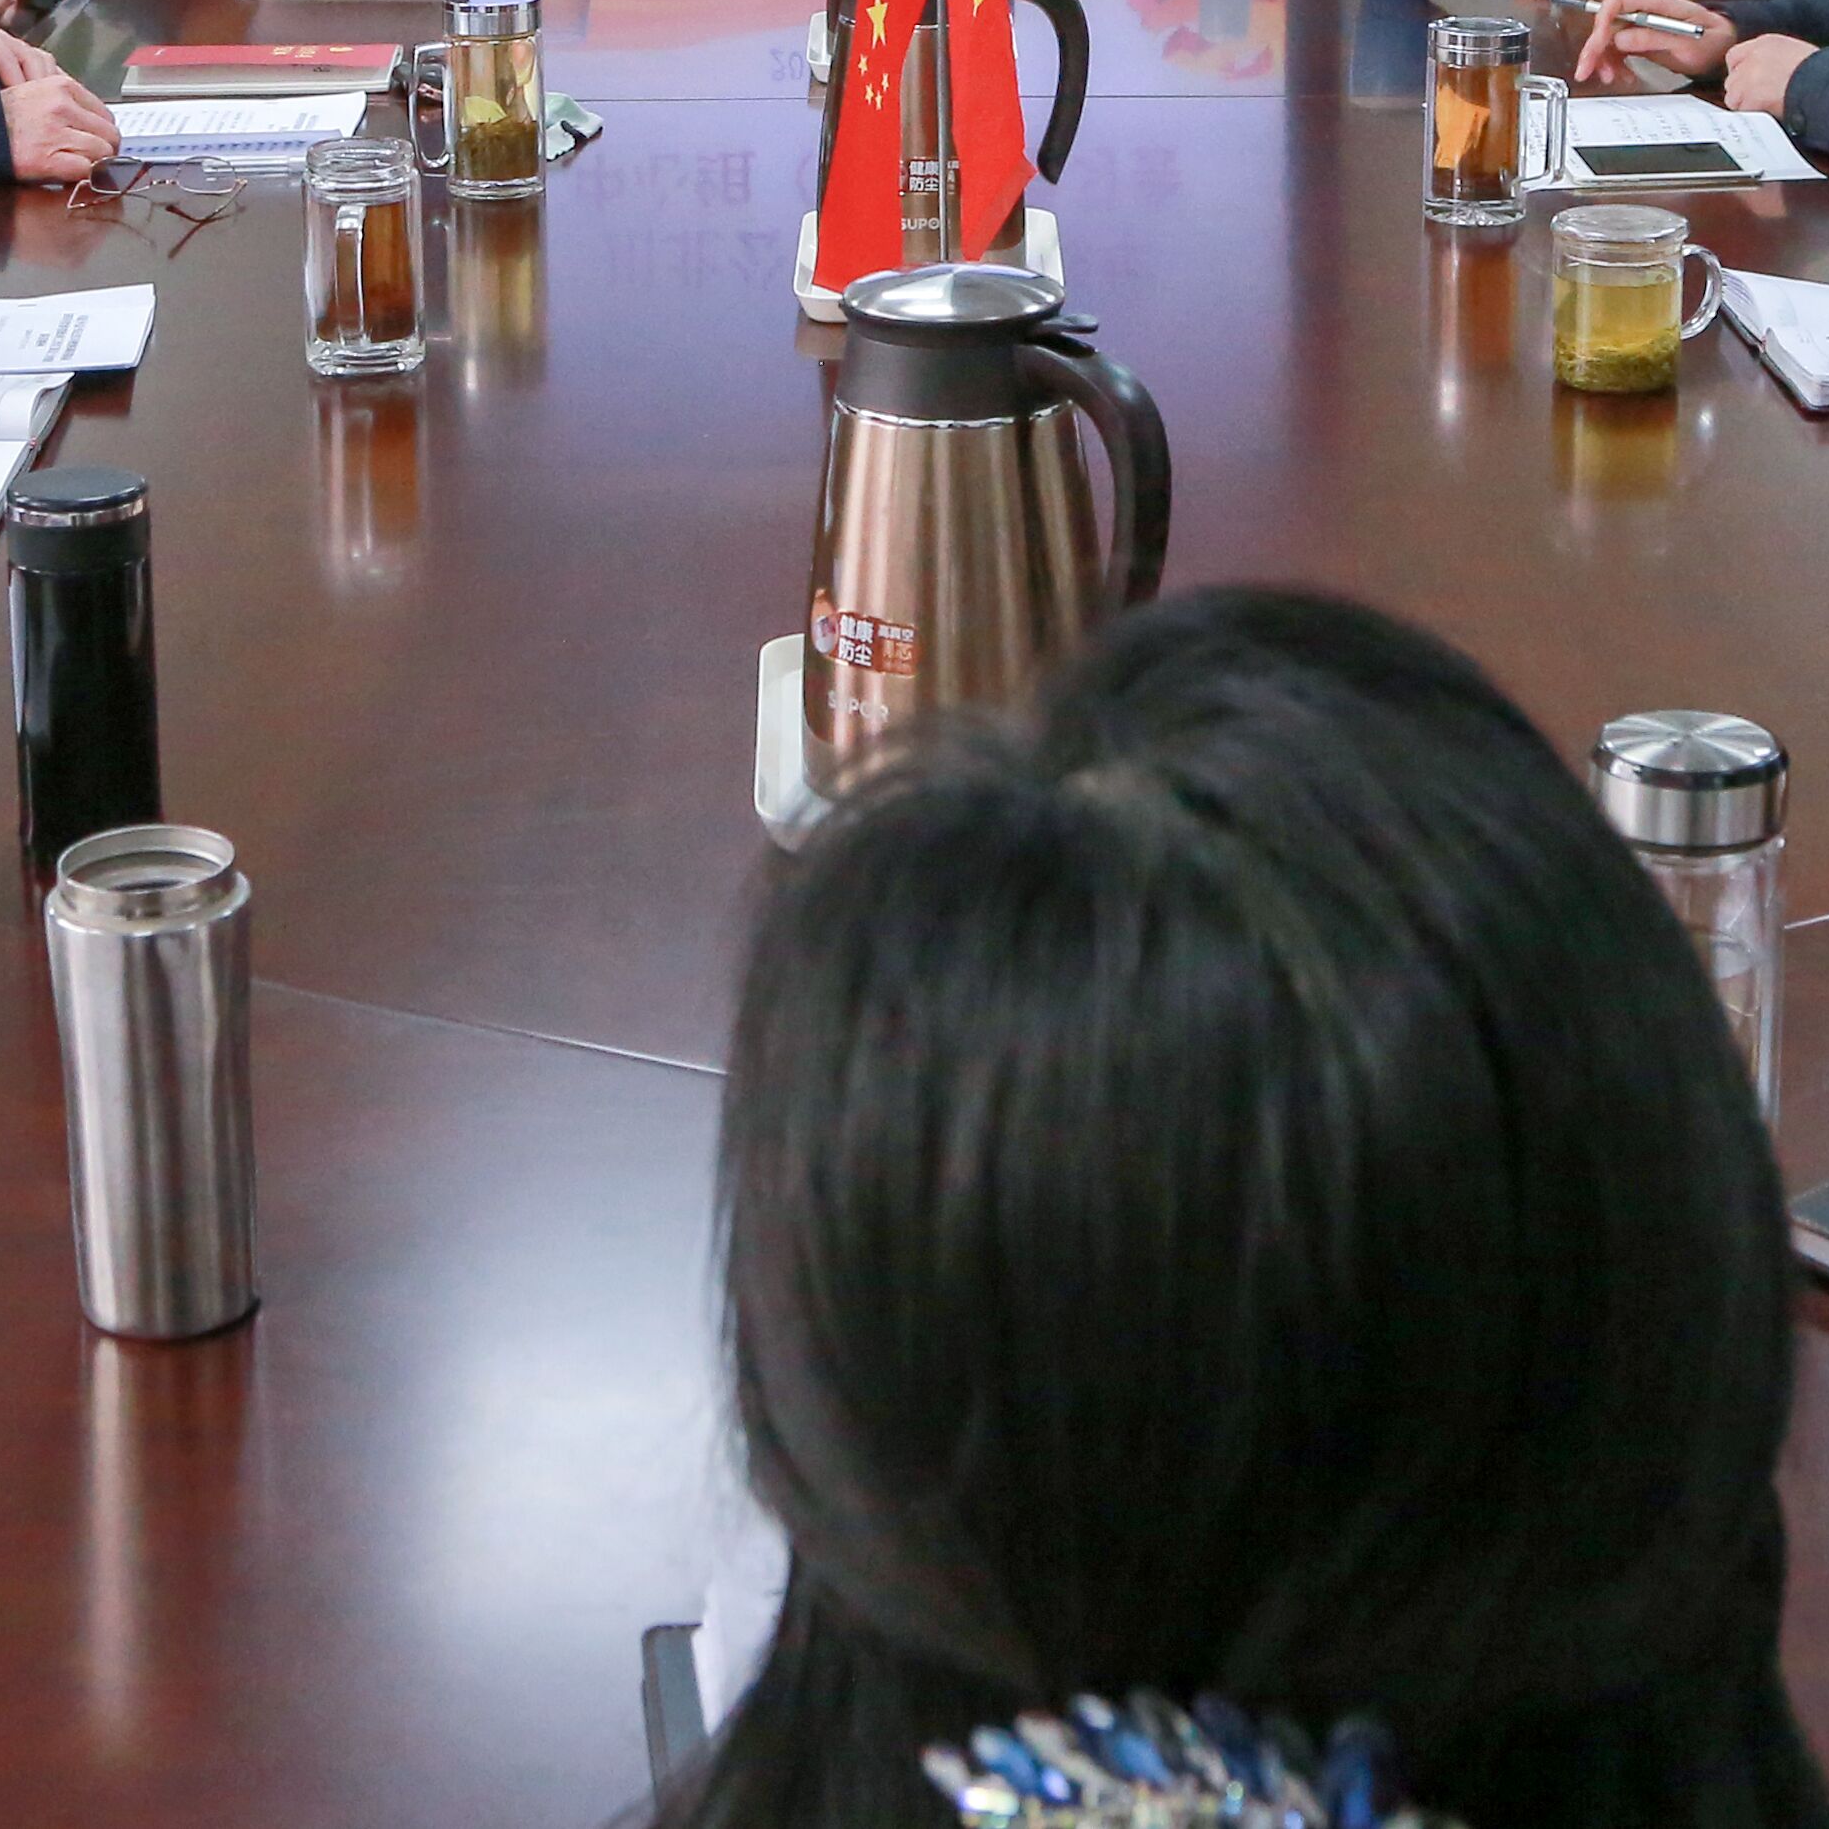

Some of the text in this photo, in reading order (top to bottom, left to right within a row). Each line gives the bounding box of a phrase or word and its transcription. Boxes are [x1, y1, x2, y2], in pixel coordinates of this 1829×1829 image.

[909, 176, 939, 192] 防尘
[901, 217, 952, 231] SUPO
[839, 614, 874, 644] 健康
[838, 637, 873, 667] 防尘
